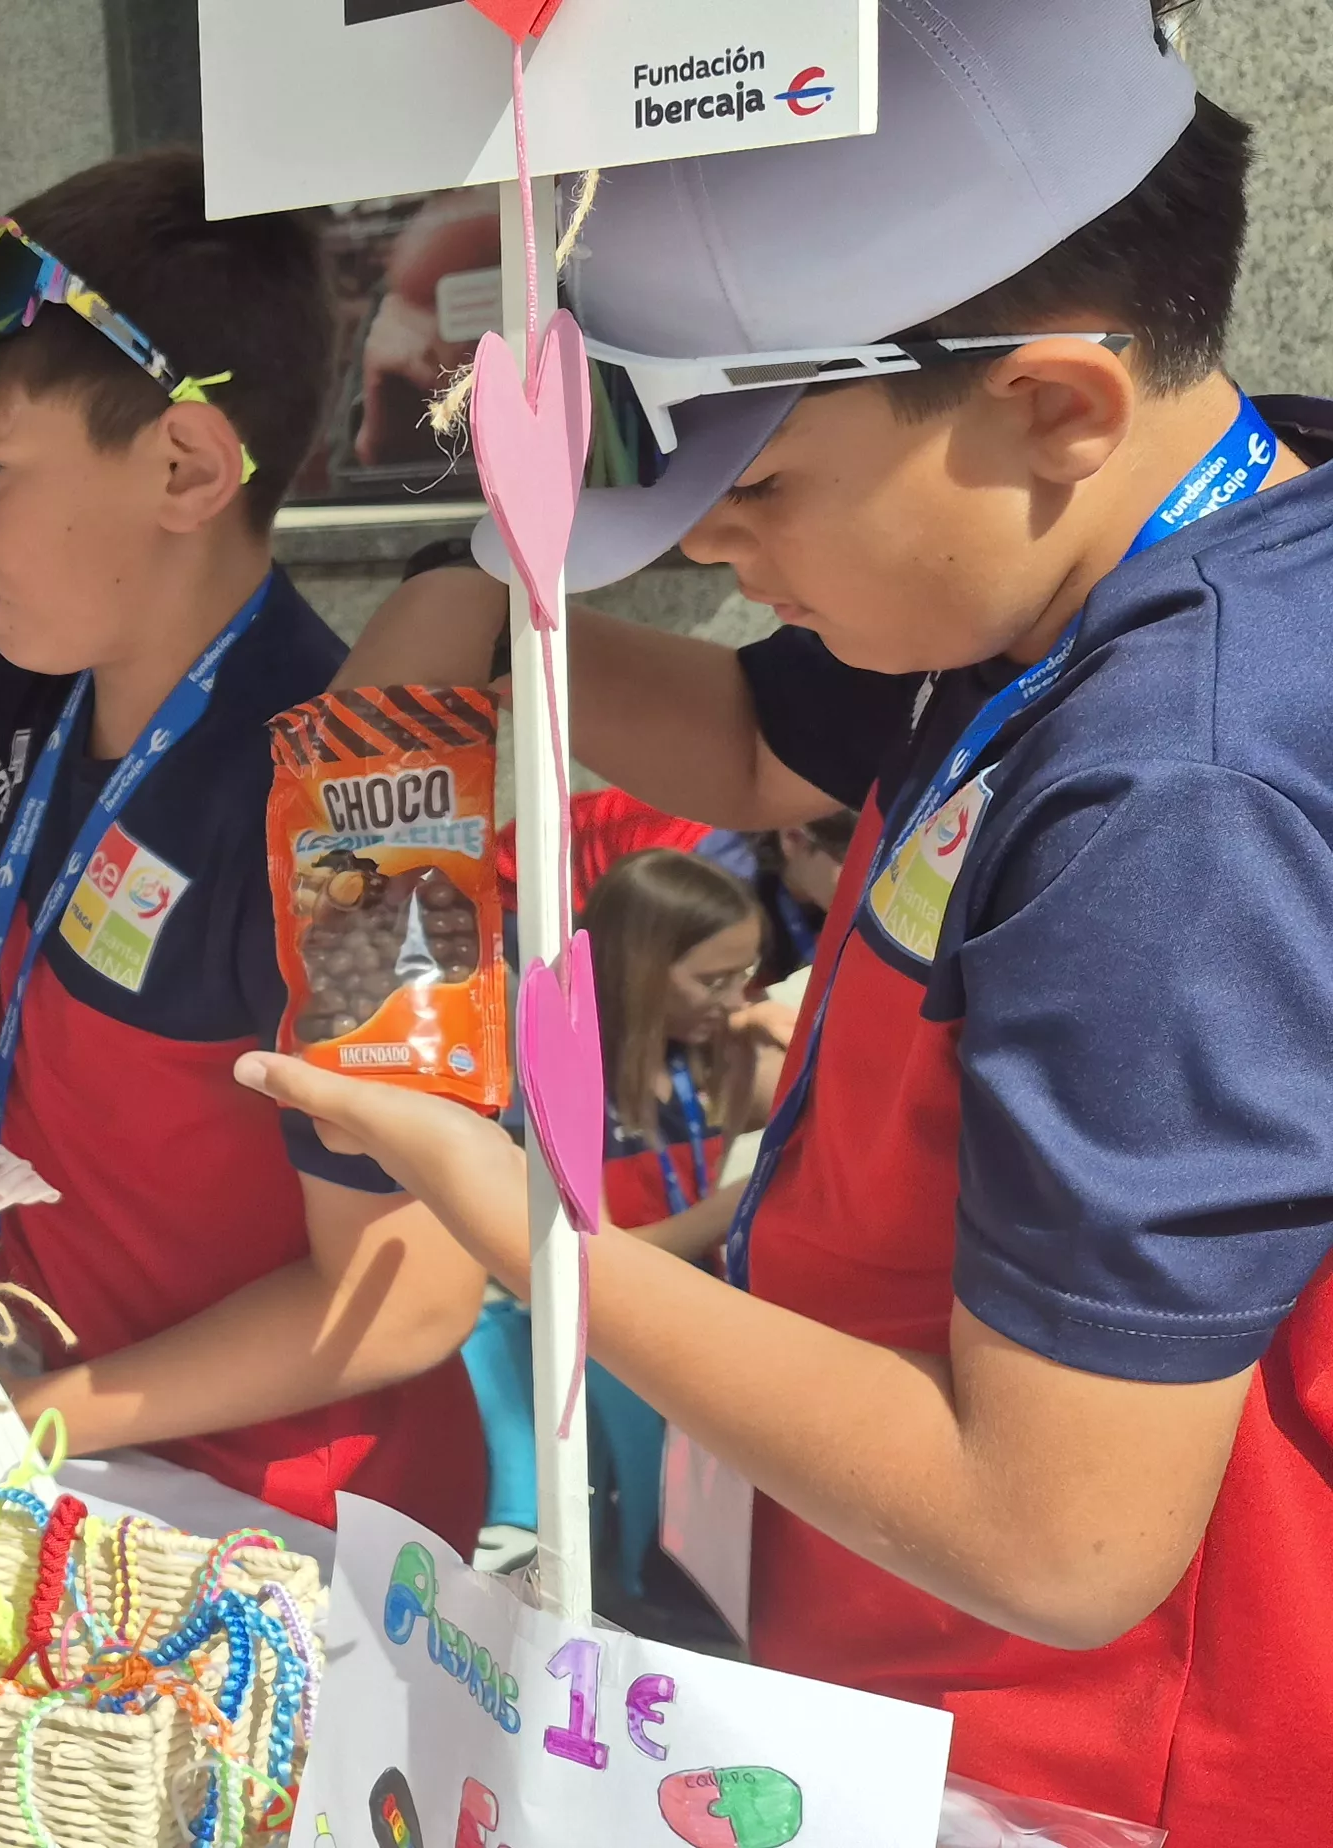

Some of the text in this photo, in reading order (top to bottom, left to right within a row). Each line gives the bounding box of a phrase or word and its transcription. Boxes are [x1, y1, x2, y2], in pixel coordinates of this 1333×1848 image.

[634, 45, 765, 89] Fundación
[635, 80, 766, 128] Ibercaja
[1159, 456, 1228, 525] Fundación
[1179, 467, 1249, 529] erCaja
[187, 632, 236, 683] Fundación
[104, 758, 145, 813] iberCaja
[322, 769, 451, 833] CHOCO
[89, 850, 122, 894] ce
[885, 905, 935, 950] ANA
[89, 947, 135, 988] ANA
[339, 1046, 410, 1063] HACENDADO
[384, 1541, 521, 1734] PIEDRAS
